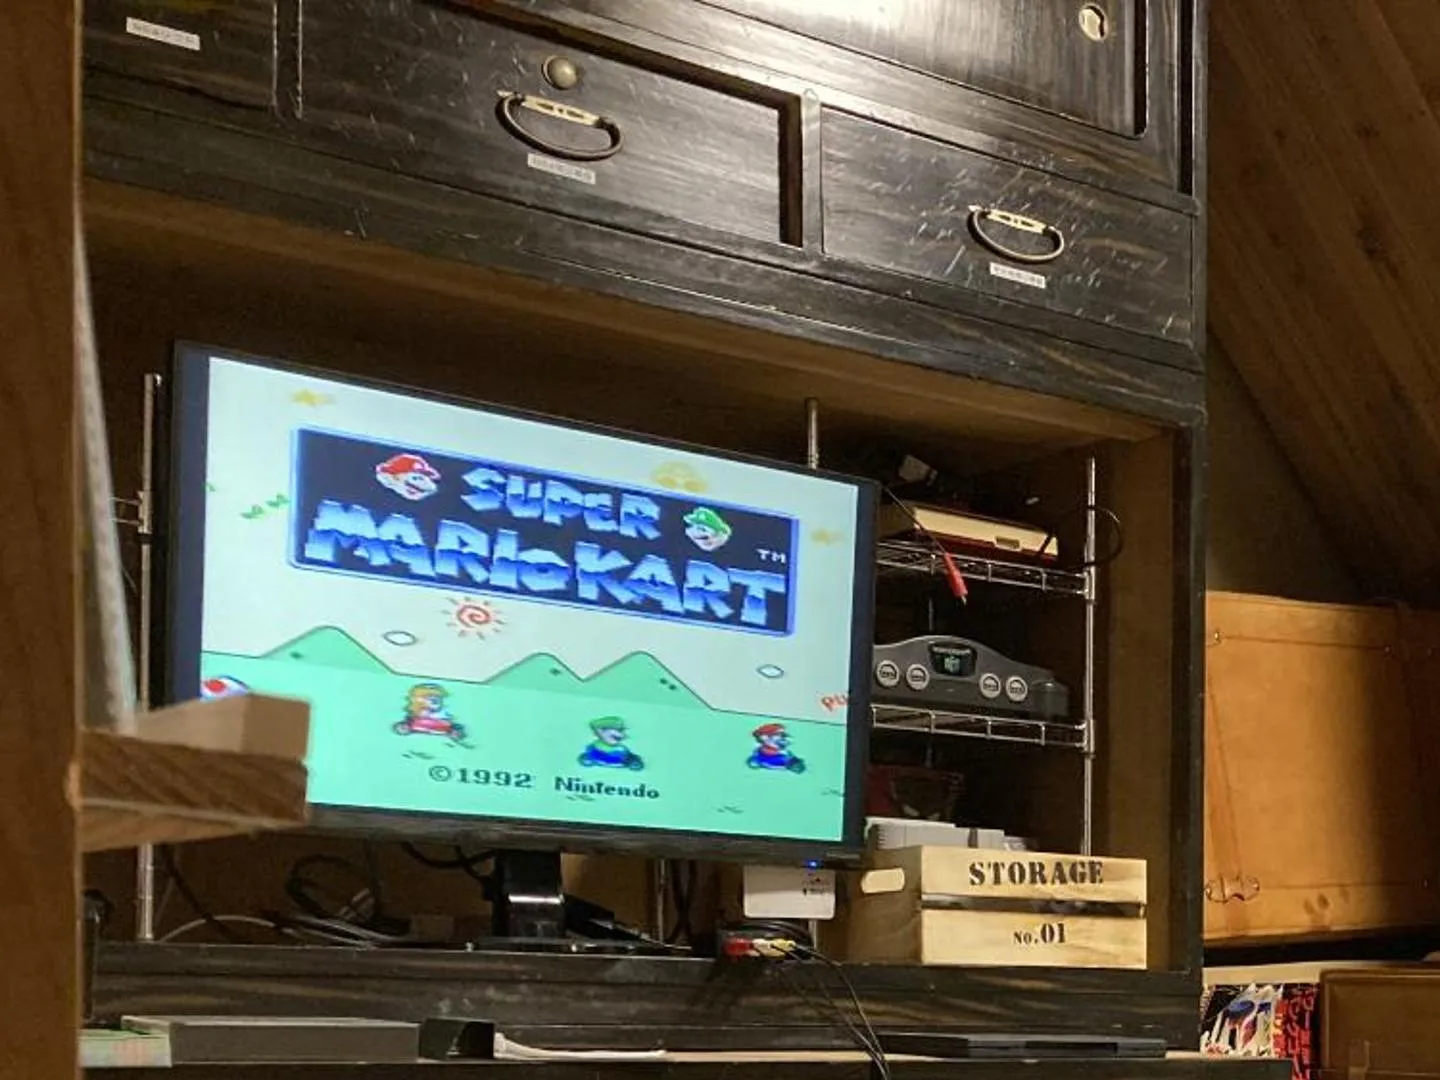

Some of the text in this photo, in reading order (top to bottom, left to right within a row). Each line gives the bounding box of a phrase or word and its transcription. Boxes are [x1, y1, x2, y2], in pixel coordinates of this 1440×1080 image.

[460, 466, 662, 541] SUPER
[554, 775, 661, 800] Nintendo
[968, 860, 1105, 886] STORAGE
